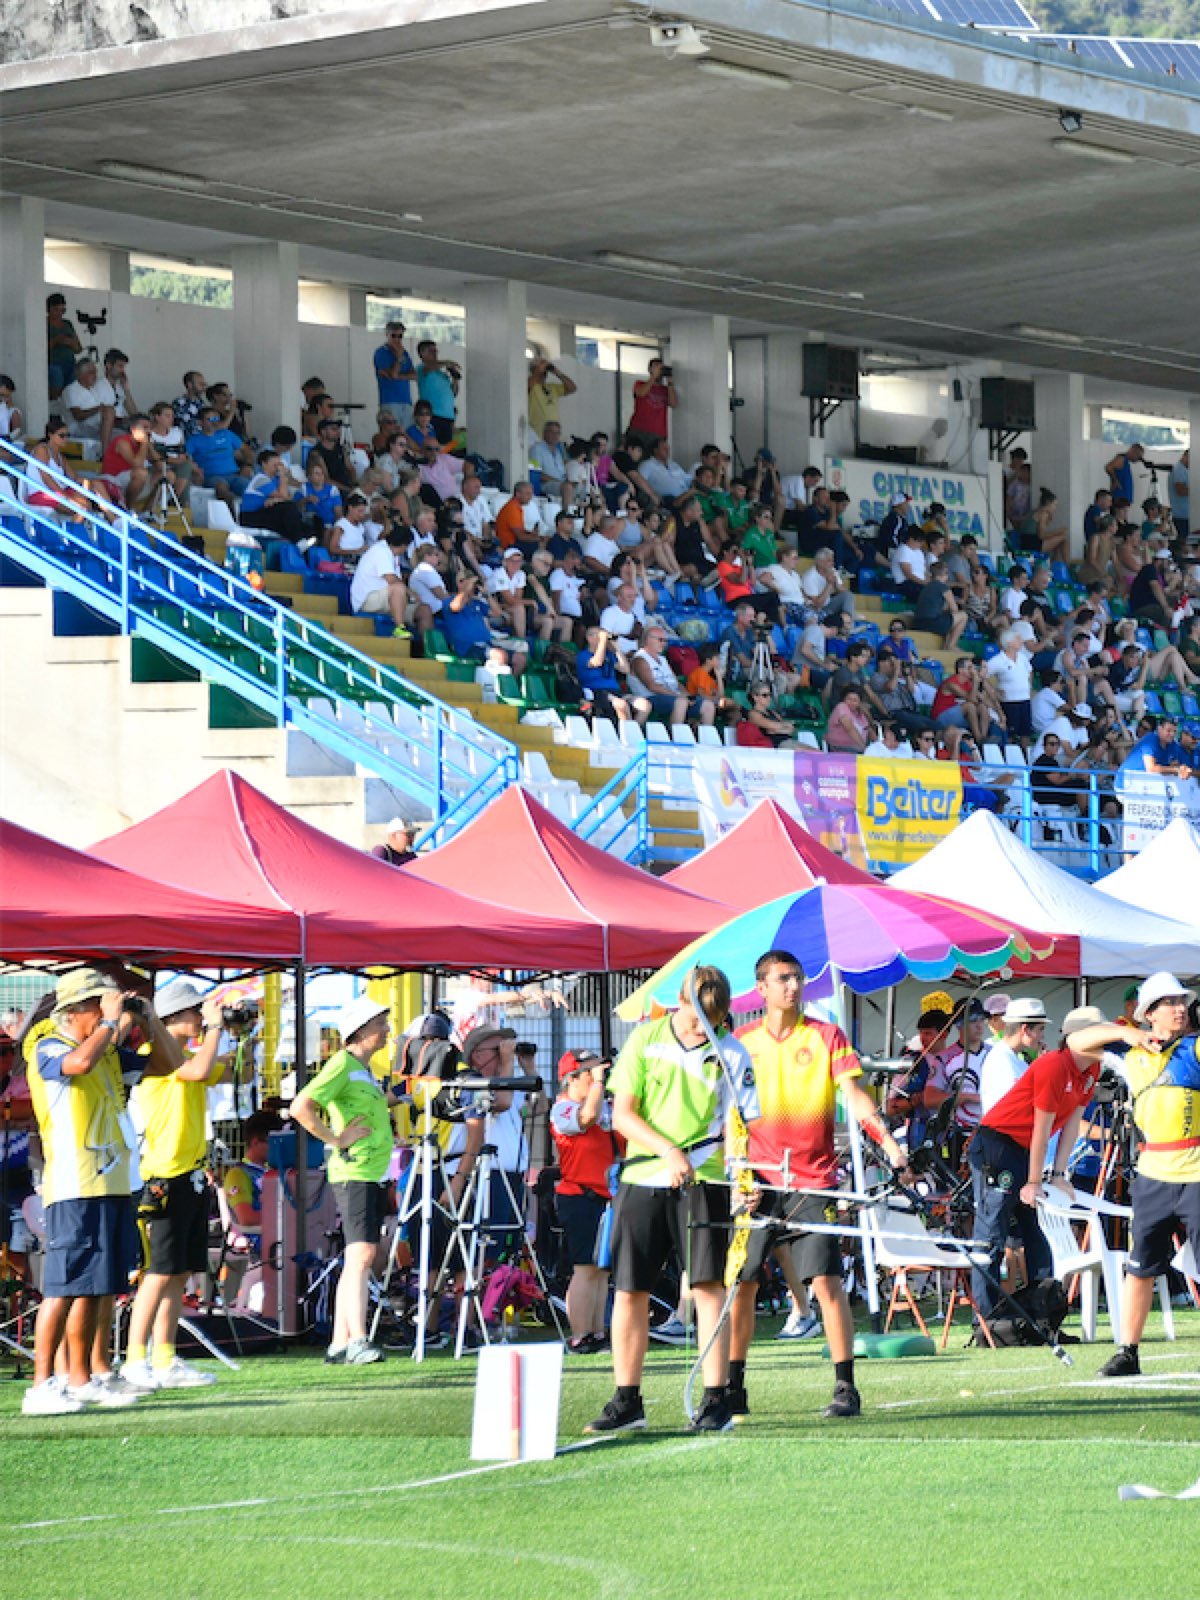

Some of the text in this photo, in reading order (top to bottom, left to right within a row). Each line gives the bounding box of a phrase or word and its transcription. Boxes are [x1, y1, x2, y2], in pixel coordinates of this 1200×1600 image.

[873, 471, 965, 506] CITTA' DI
[867, 776, 956, 825] Beiter
